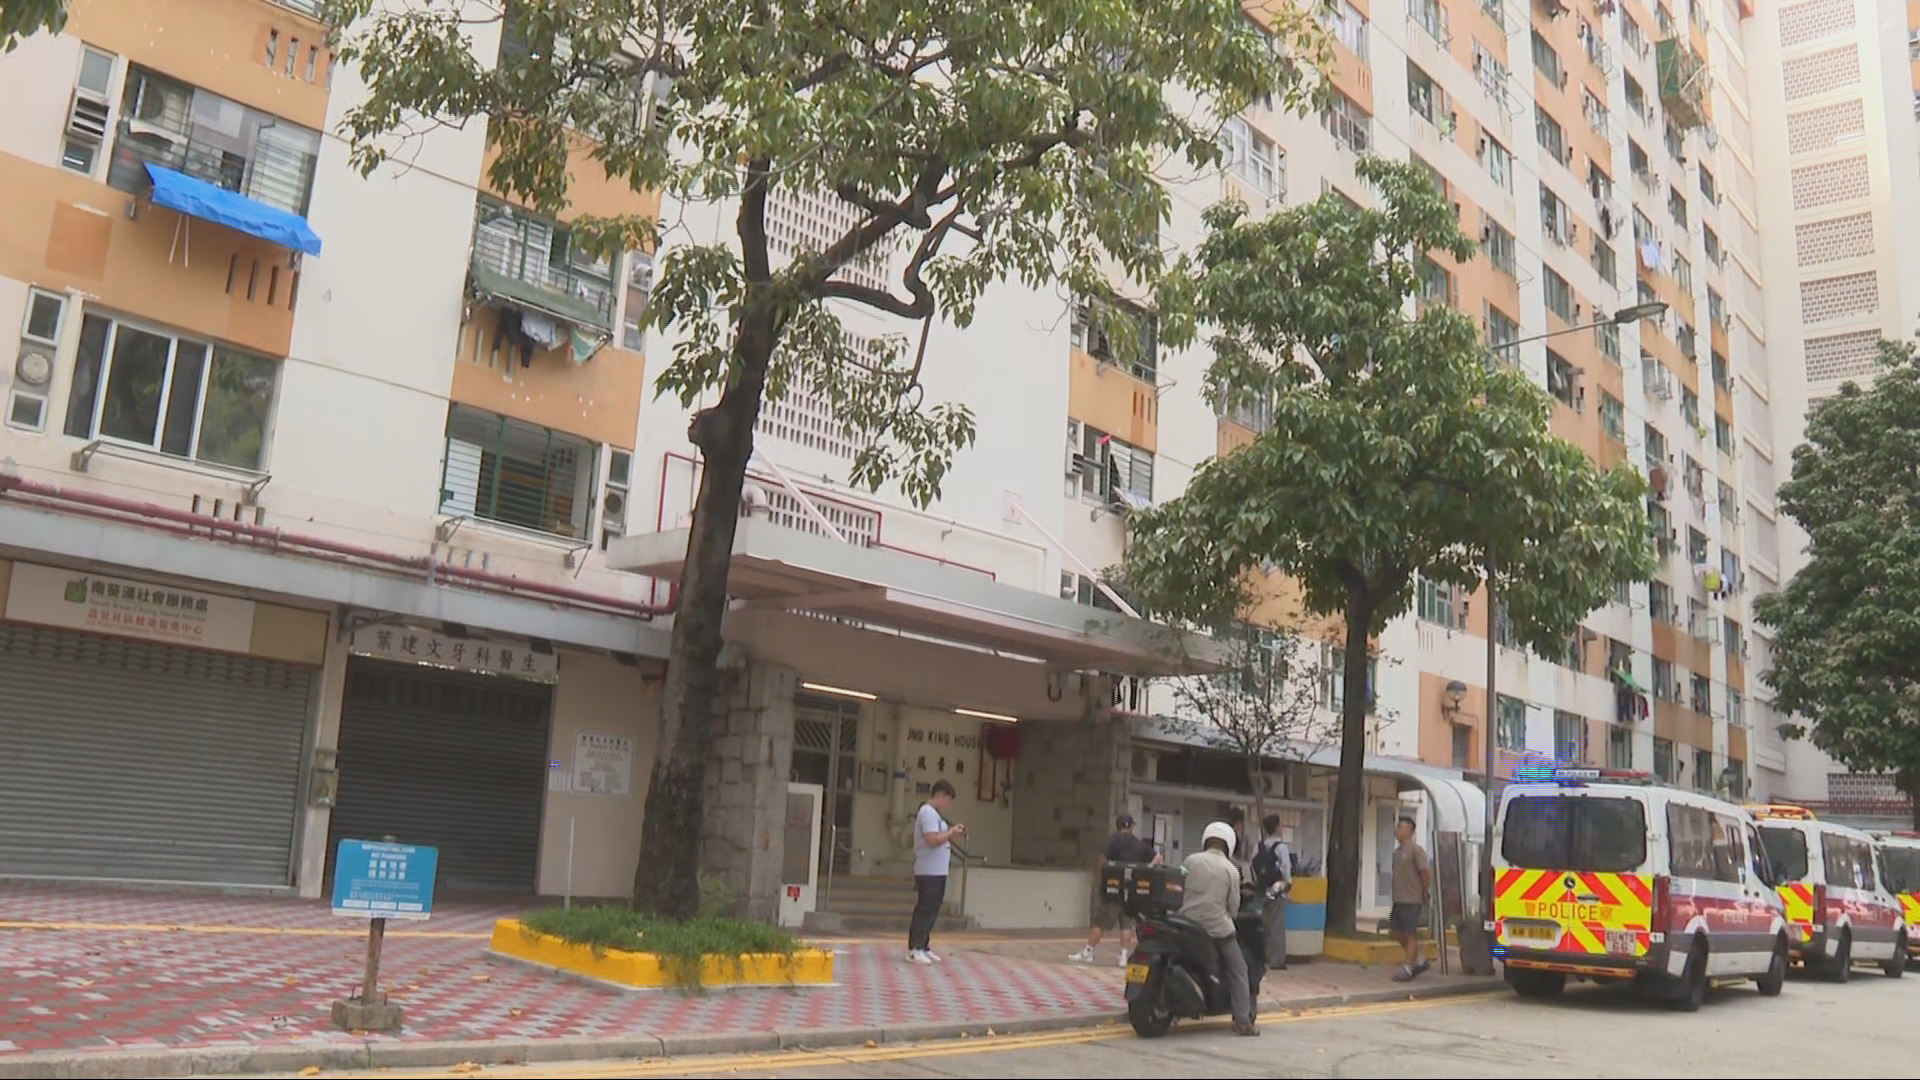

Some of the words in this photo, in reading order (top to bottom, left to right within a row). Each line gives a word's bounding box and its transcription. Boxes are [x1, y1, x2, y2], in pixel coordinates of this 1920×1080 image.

[376, 629, 536, 673] 葉建文牙科醫生
[928, 731, 950, 746] KING
[1538, 902, 1598, 921] POLICE
